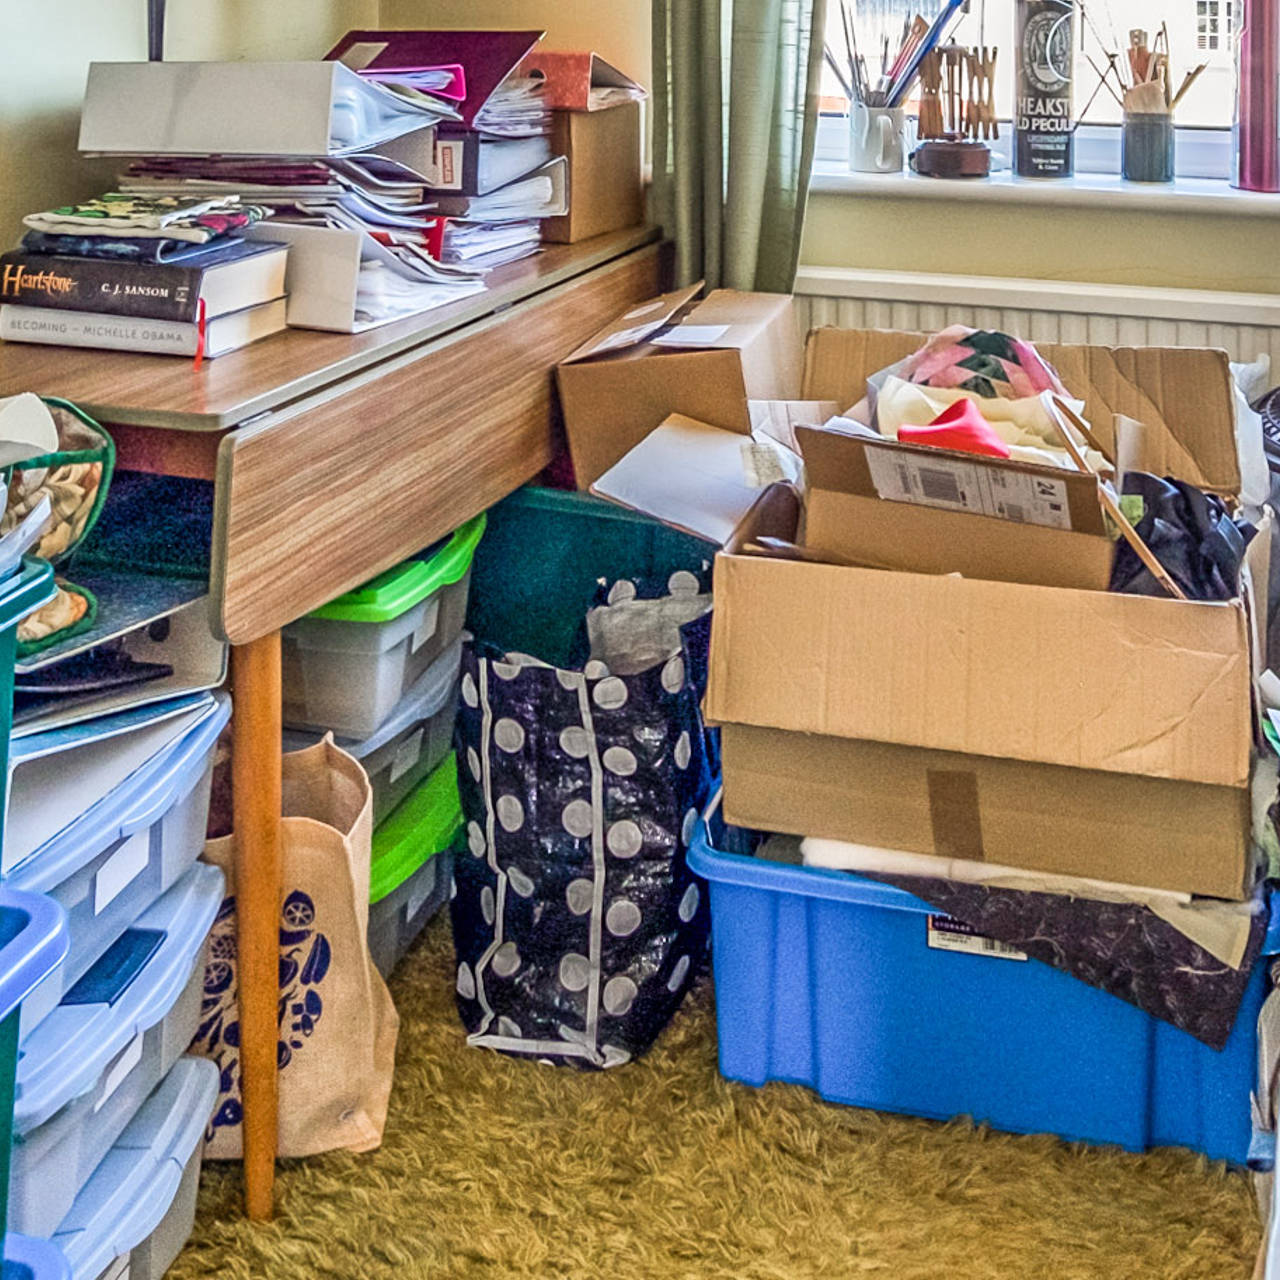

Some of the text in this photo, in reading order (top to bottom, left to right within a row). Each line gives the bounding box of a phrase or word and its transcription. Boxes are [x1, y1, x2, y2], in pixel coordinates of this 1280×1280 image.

[1017, 97, 1070, 116] HEAKST
[1017, 118, 1073, 132] LD PECUL
[2, 264, 170, 299] Heartstone C. J. SANSOM
[9, 320, 185, 343] BECOMING MICHELLE OBAMA
[1036, 480, 1057, 497] 24
